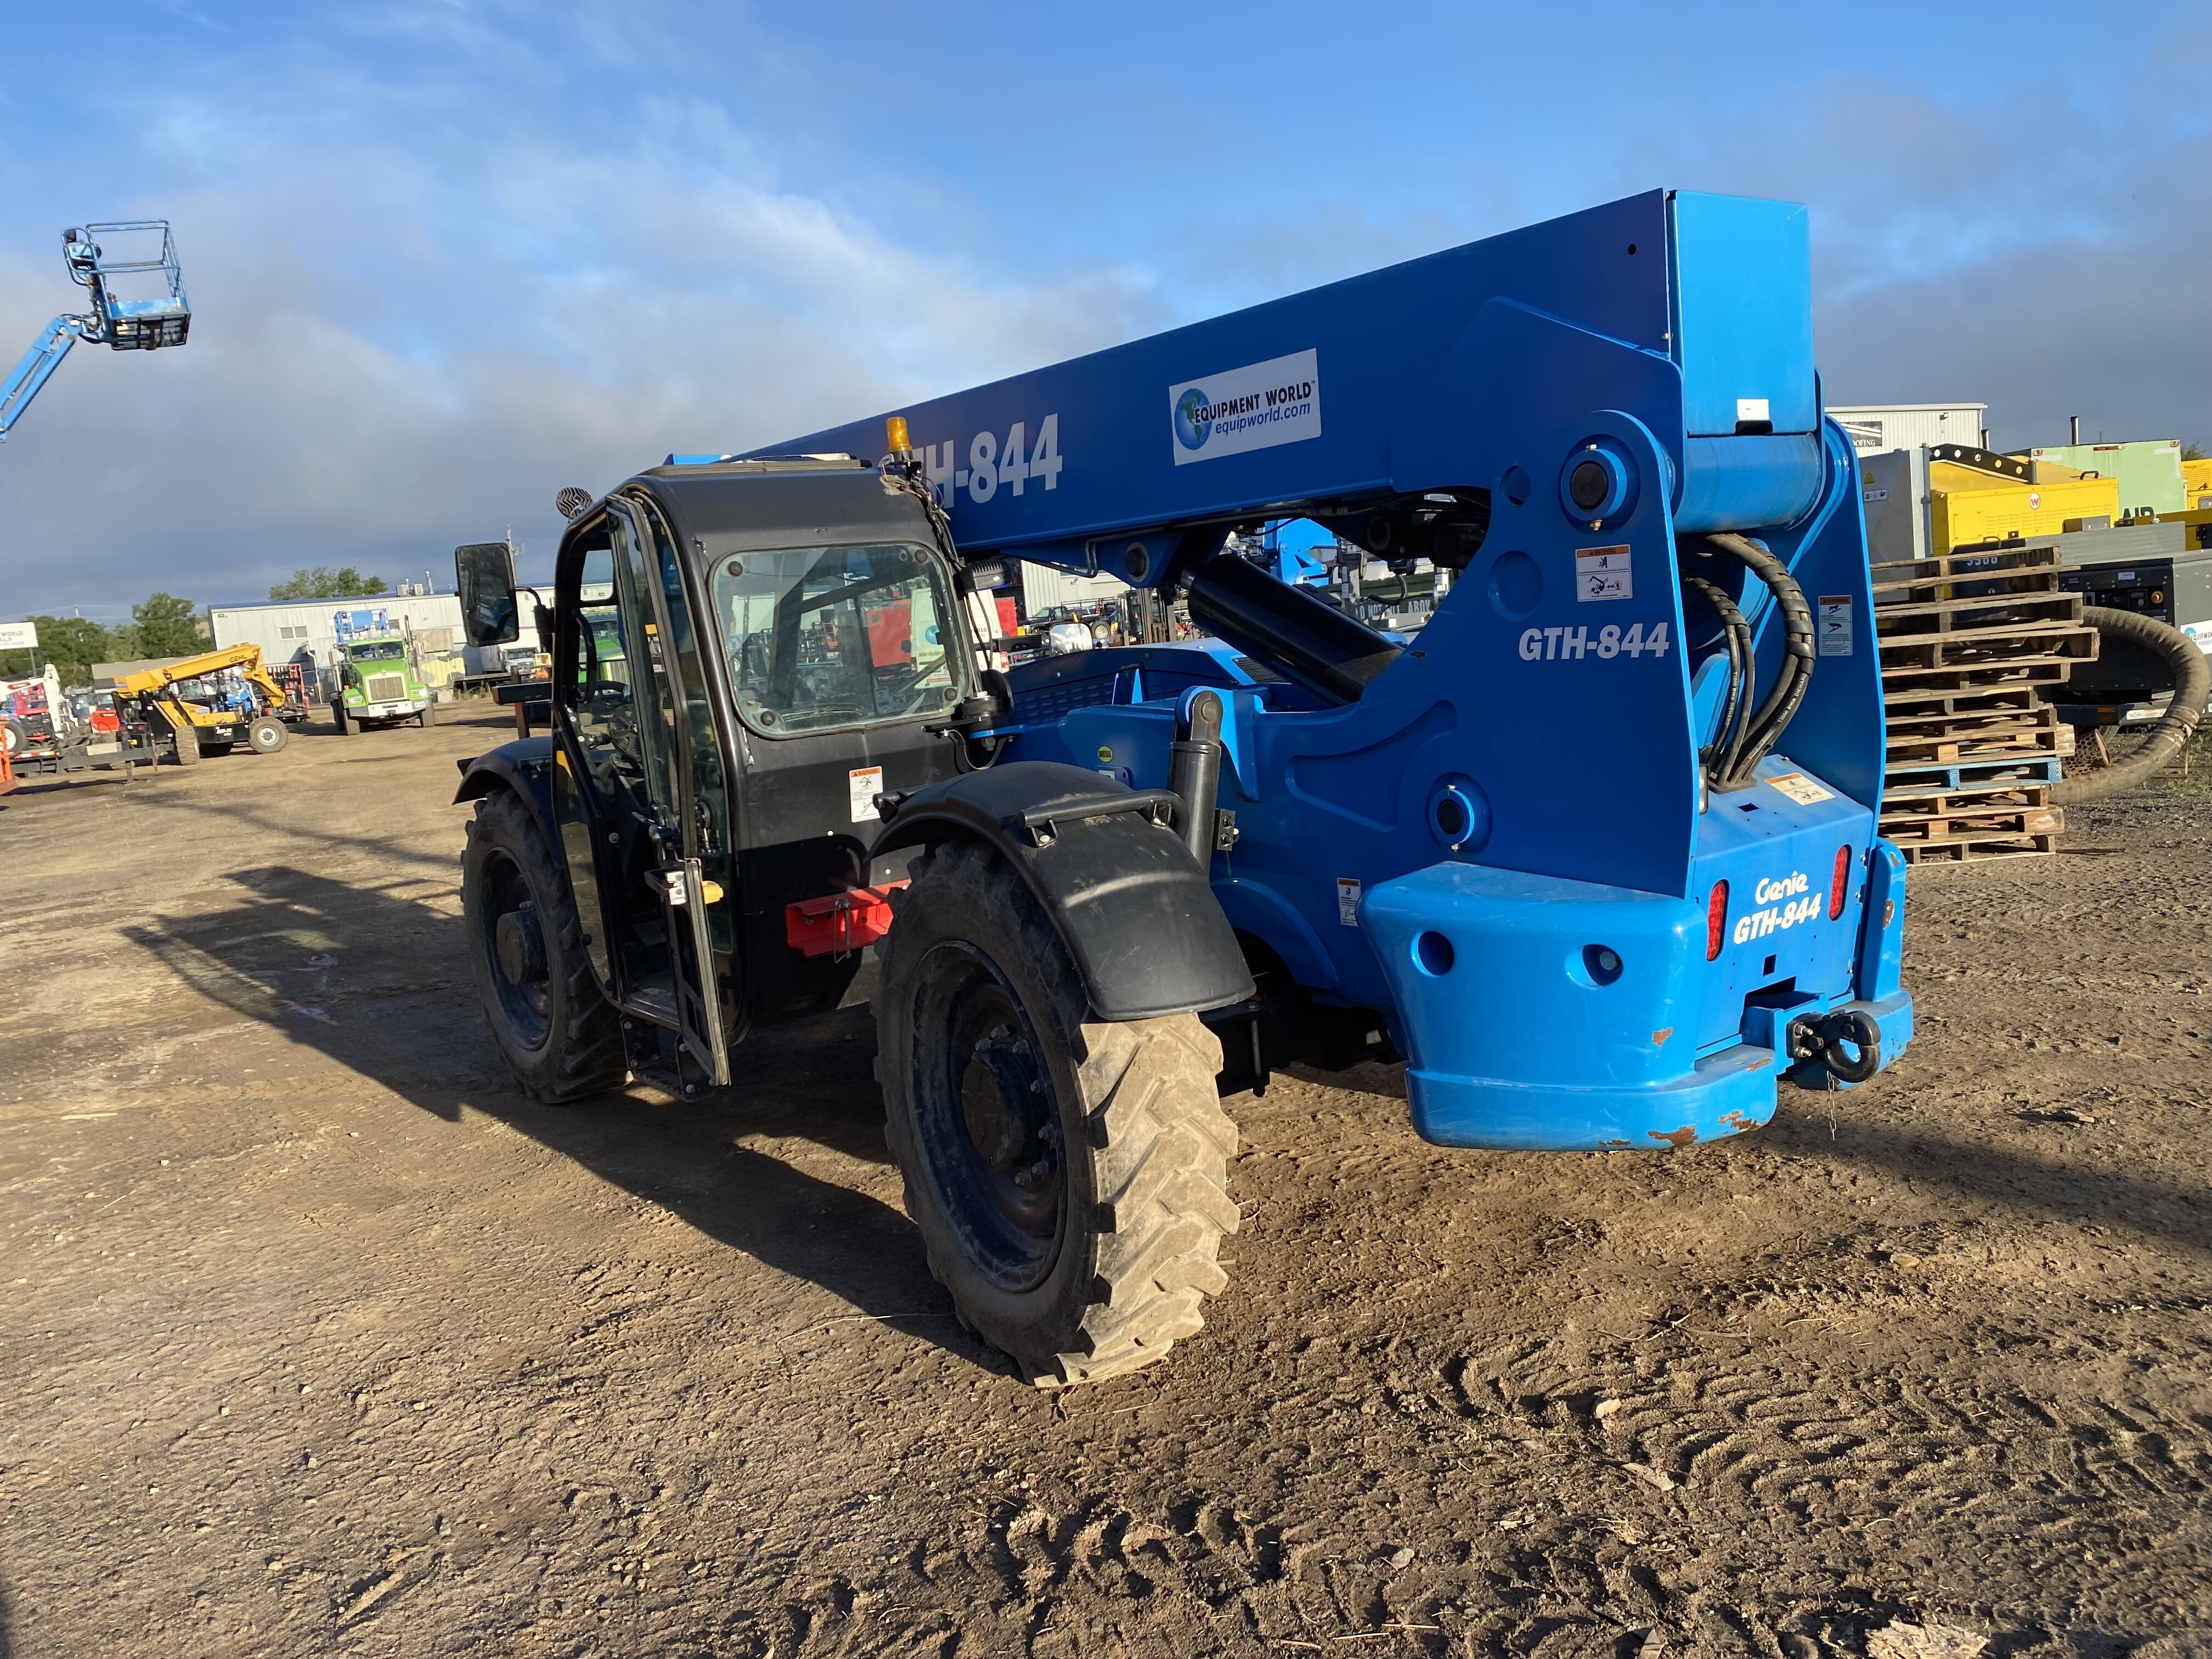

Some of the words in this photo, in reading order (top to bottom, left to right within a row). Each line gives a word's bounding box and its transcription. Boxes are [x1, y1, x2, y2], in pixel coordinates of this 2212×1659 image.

[1194, 393, 1260, 424] EQUIPMENT
[1216, 403, 1310, 436] equipworld.com
[912, 413, 1063, 509] H-844
[1519, 622, 1669, 661] GTH-844
[1756, 871, 1809, 905] Genie
[1734, 893, 1822, 945] GTH-844
